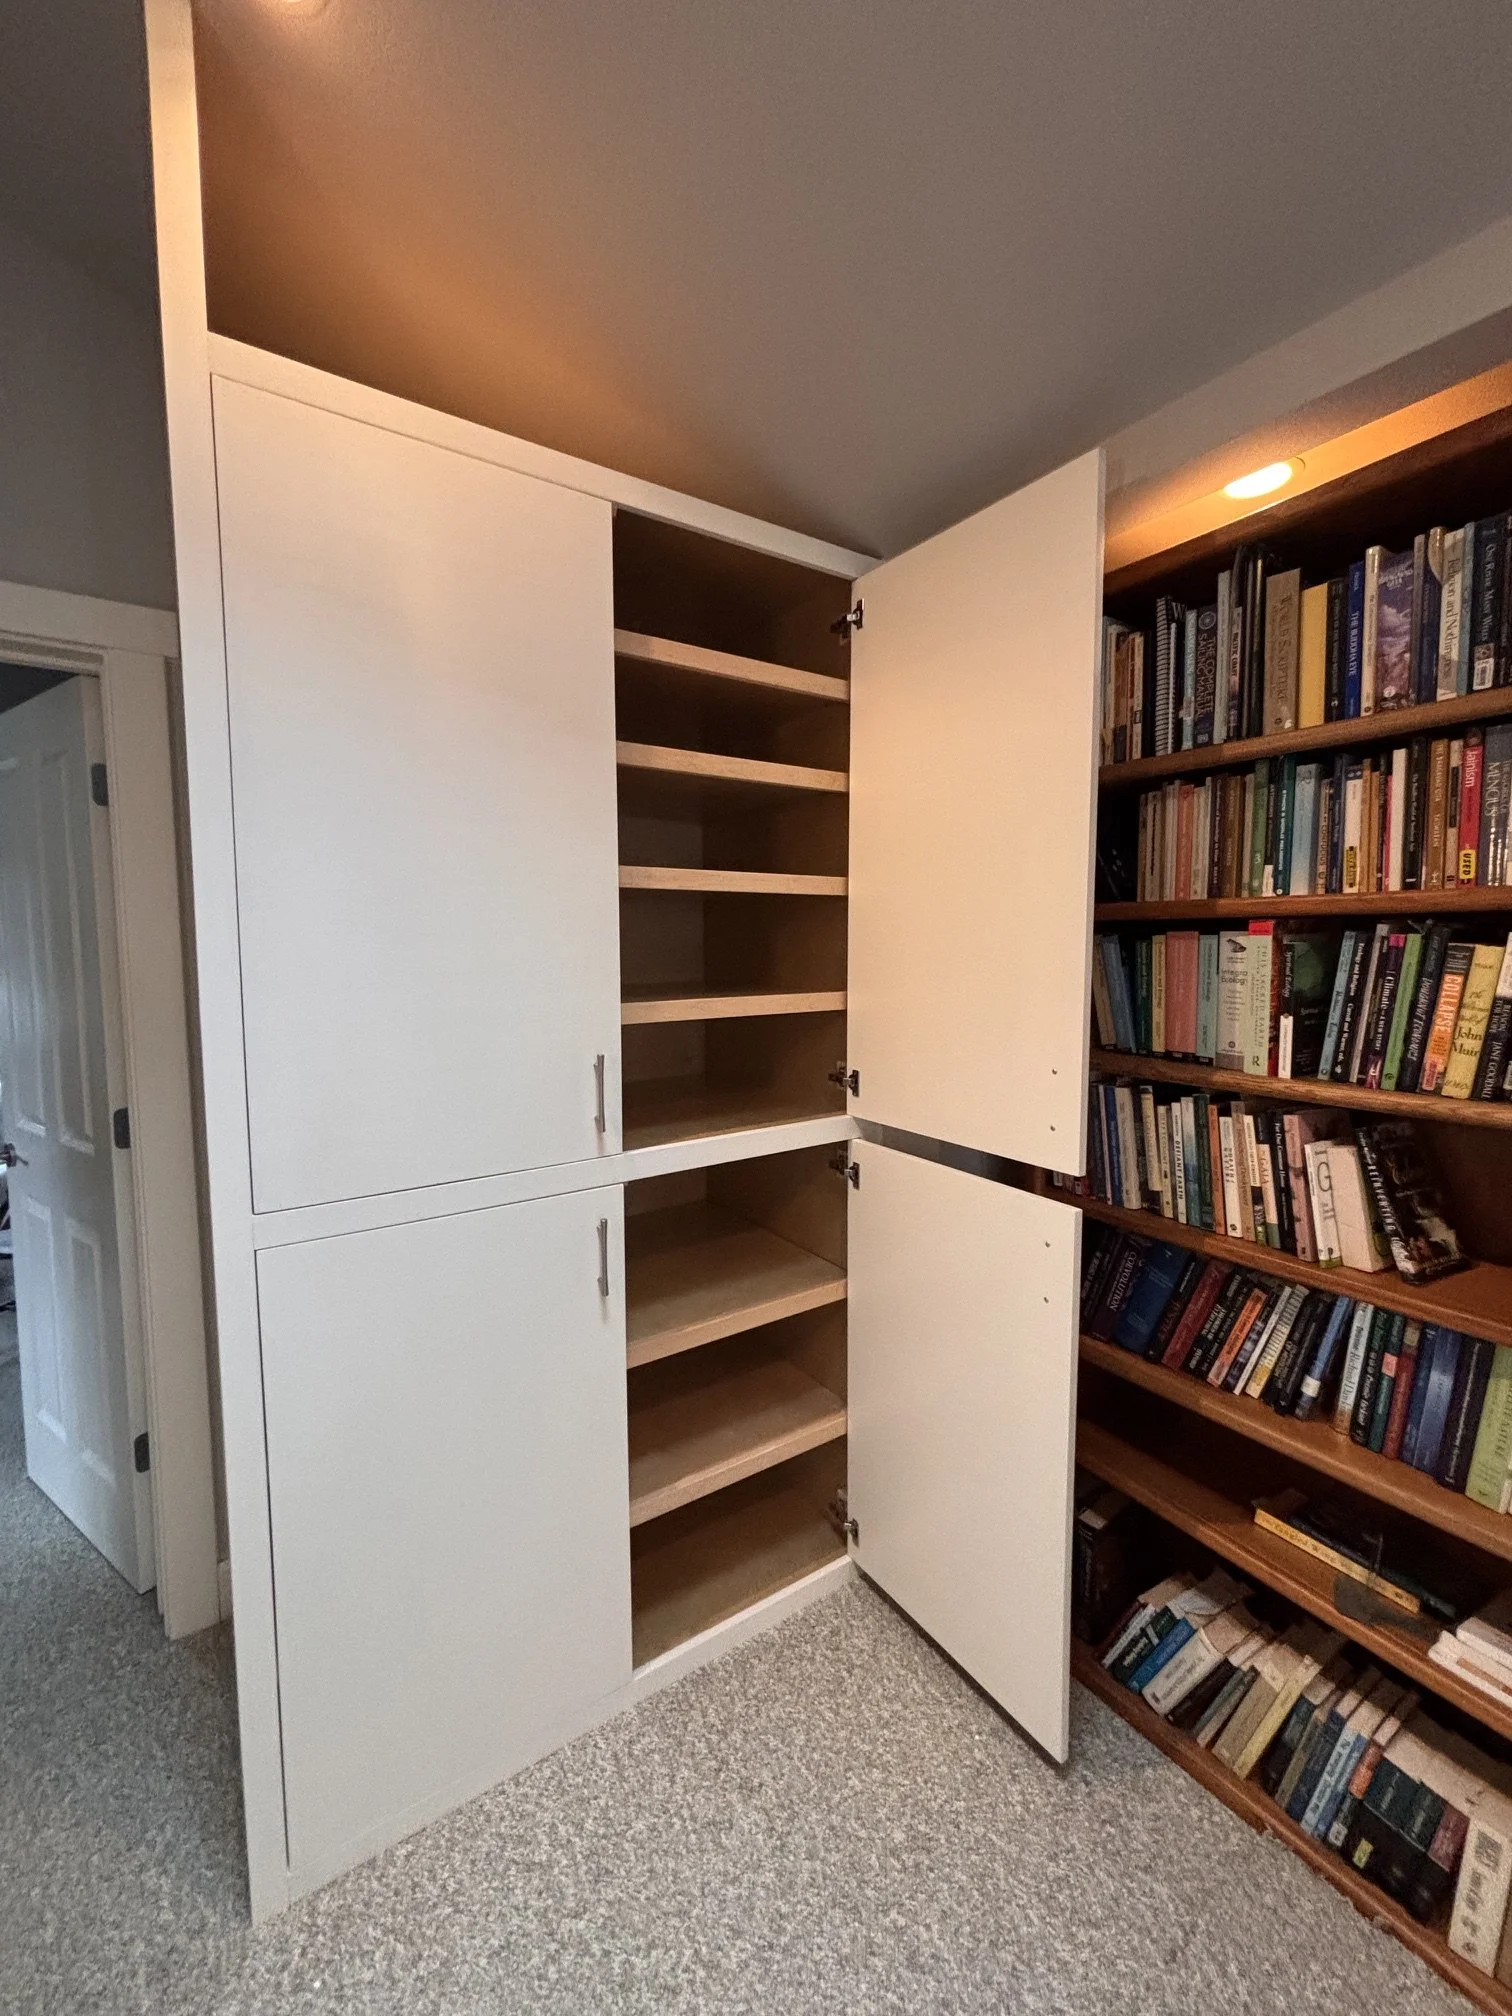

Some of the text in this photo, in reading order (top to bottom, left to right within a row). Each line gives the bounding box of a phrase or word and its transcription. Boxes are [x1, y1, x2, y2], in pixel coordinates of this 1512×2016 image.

[1196, 633, 1207, 720] SAILING MANUAL
[1203, 659, 1215, 713] COMPLETE
[1464, 750, 1478, 788] Jainism
[1484, 762, 1500, 816] MENCIUS
[1462, 853, 1472, 876] USED
[1380, 975, 1395, 1010] Climate
[1407, 977, 1433, 1061] DOUGHNUT ECONOMICS
[1434, 975, 1462, 1033] COLLAPSE
[1450, 1042, 1479, 1058] Muir
[1454, 1026, 1482, 1041] John
[1482, 1041, 1502, 1099] JANE GOODALL
[1258, 1157, 1269, 1184] GAIA
[1367, 1165, 1396, 1231] REINVENTING
[1109, 1251, 1137, 1312] COEVOLUTION
[1346, 1352, 1360, 1385] Richard
